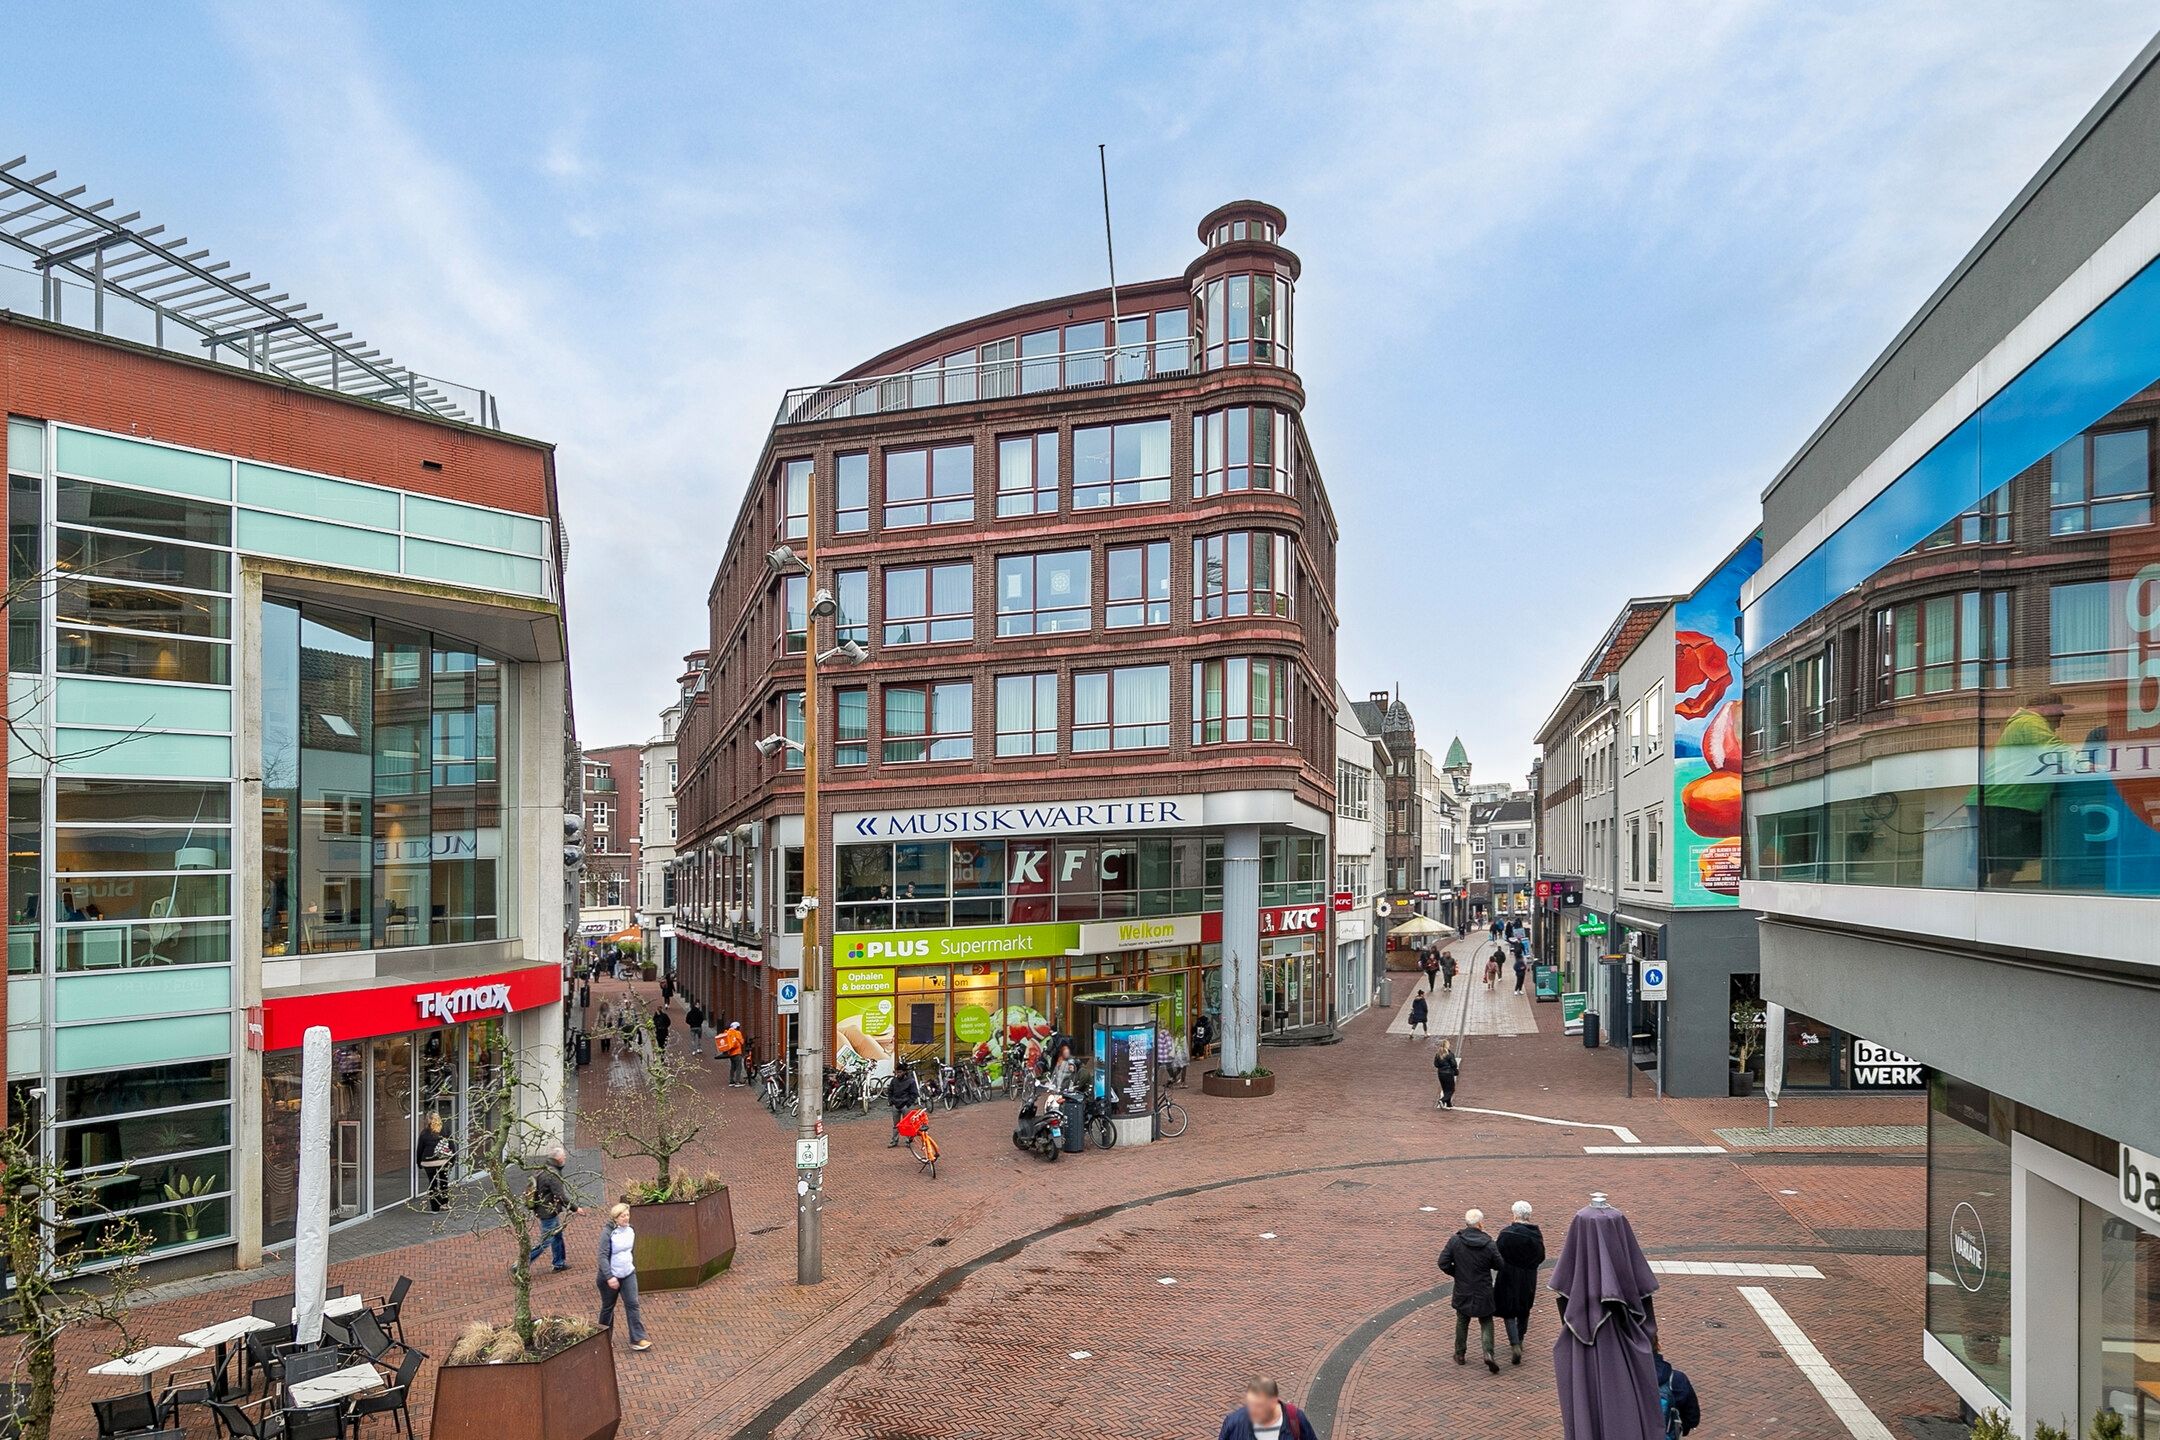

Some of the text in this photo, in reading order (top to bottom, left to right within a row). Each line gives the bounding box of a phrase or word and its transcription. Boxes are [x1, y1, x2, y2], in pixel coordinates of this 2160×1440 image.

[887, 800, 1185, 835] MUSISKWARTIER
[1009, 848, 1126, 884] KFC
[1280, 908, 1320, 931] KFC
[1120, 922, 1174, 940] Welkom
[868, 934, 1033, 958] PLUS Supermarkt
[848, 973, 884, 982] Ophalen
[850, 982, 890, 992] bezorgen
[1854, 1067, 1922, 1085] WERK
